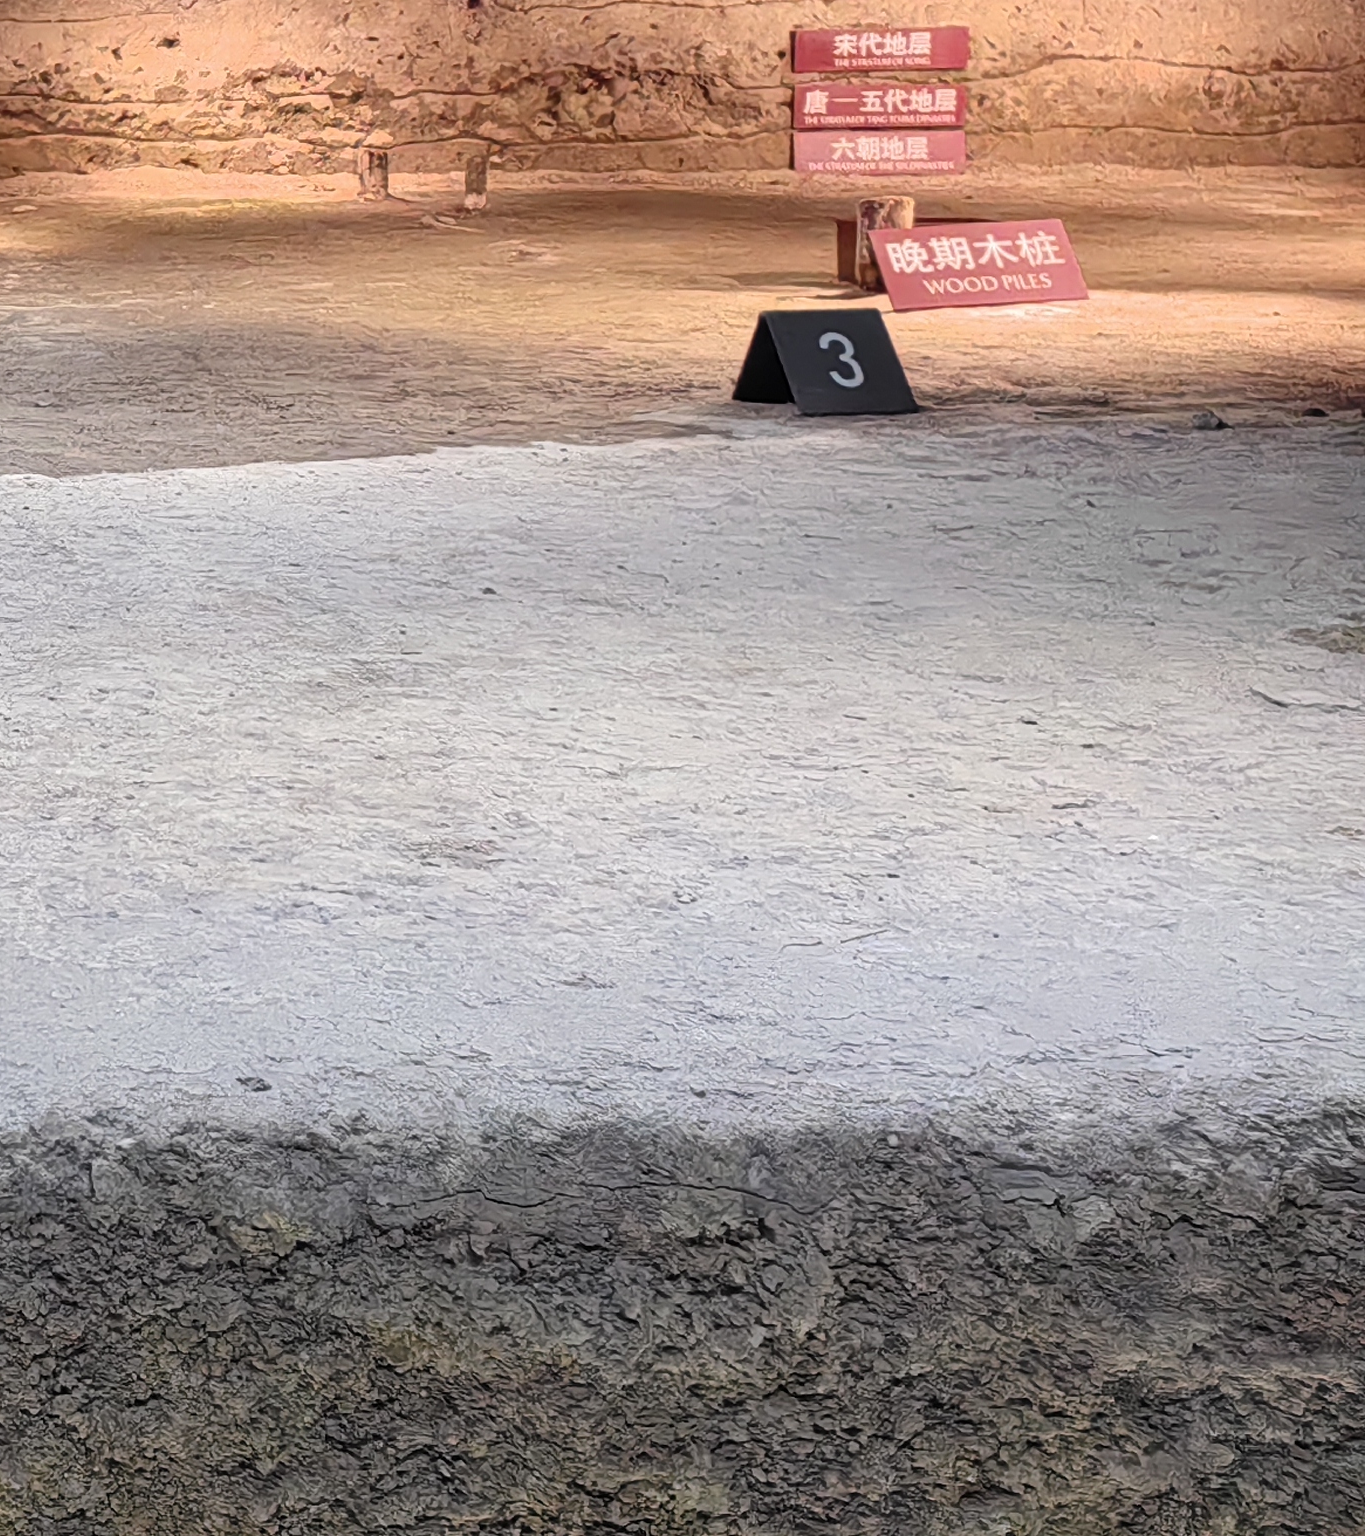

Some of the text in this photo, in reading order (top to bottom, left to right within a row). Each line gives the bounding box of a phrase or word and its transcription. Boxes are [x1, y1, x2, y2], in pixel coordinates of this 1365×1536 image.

[833, 31, 932, 57] 宋代地层
[830, 135, 930, 161] 六朝地层
[885, 229, 1066, 274] 晚期木桩
[922, 272, 1053, 295] WOOD PILES
[819, 331, 865, 388] 3
